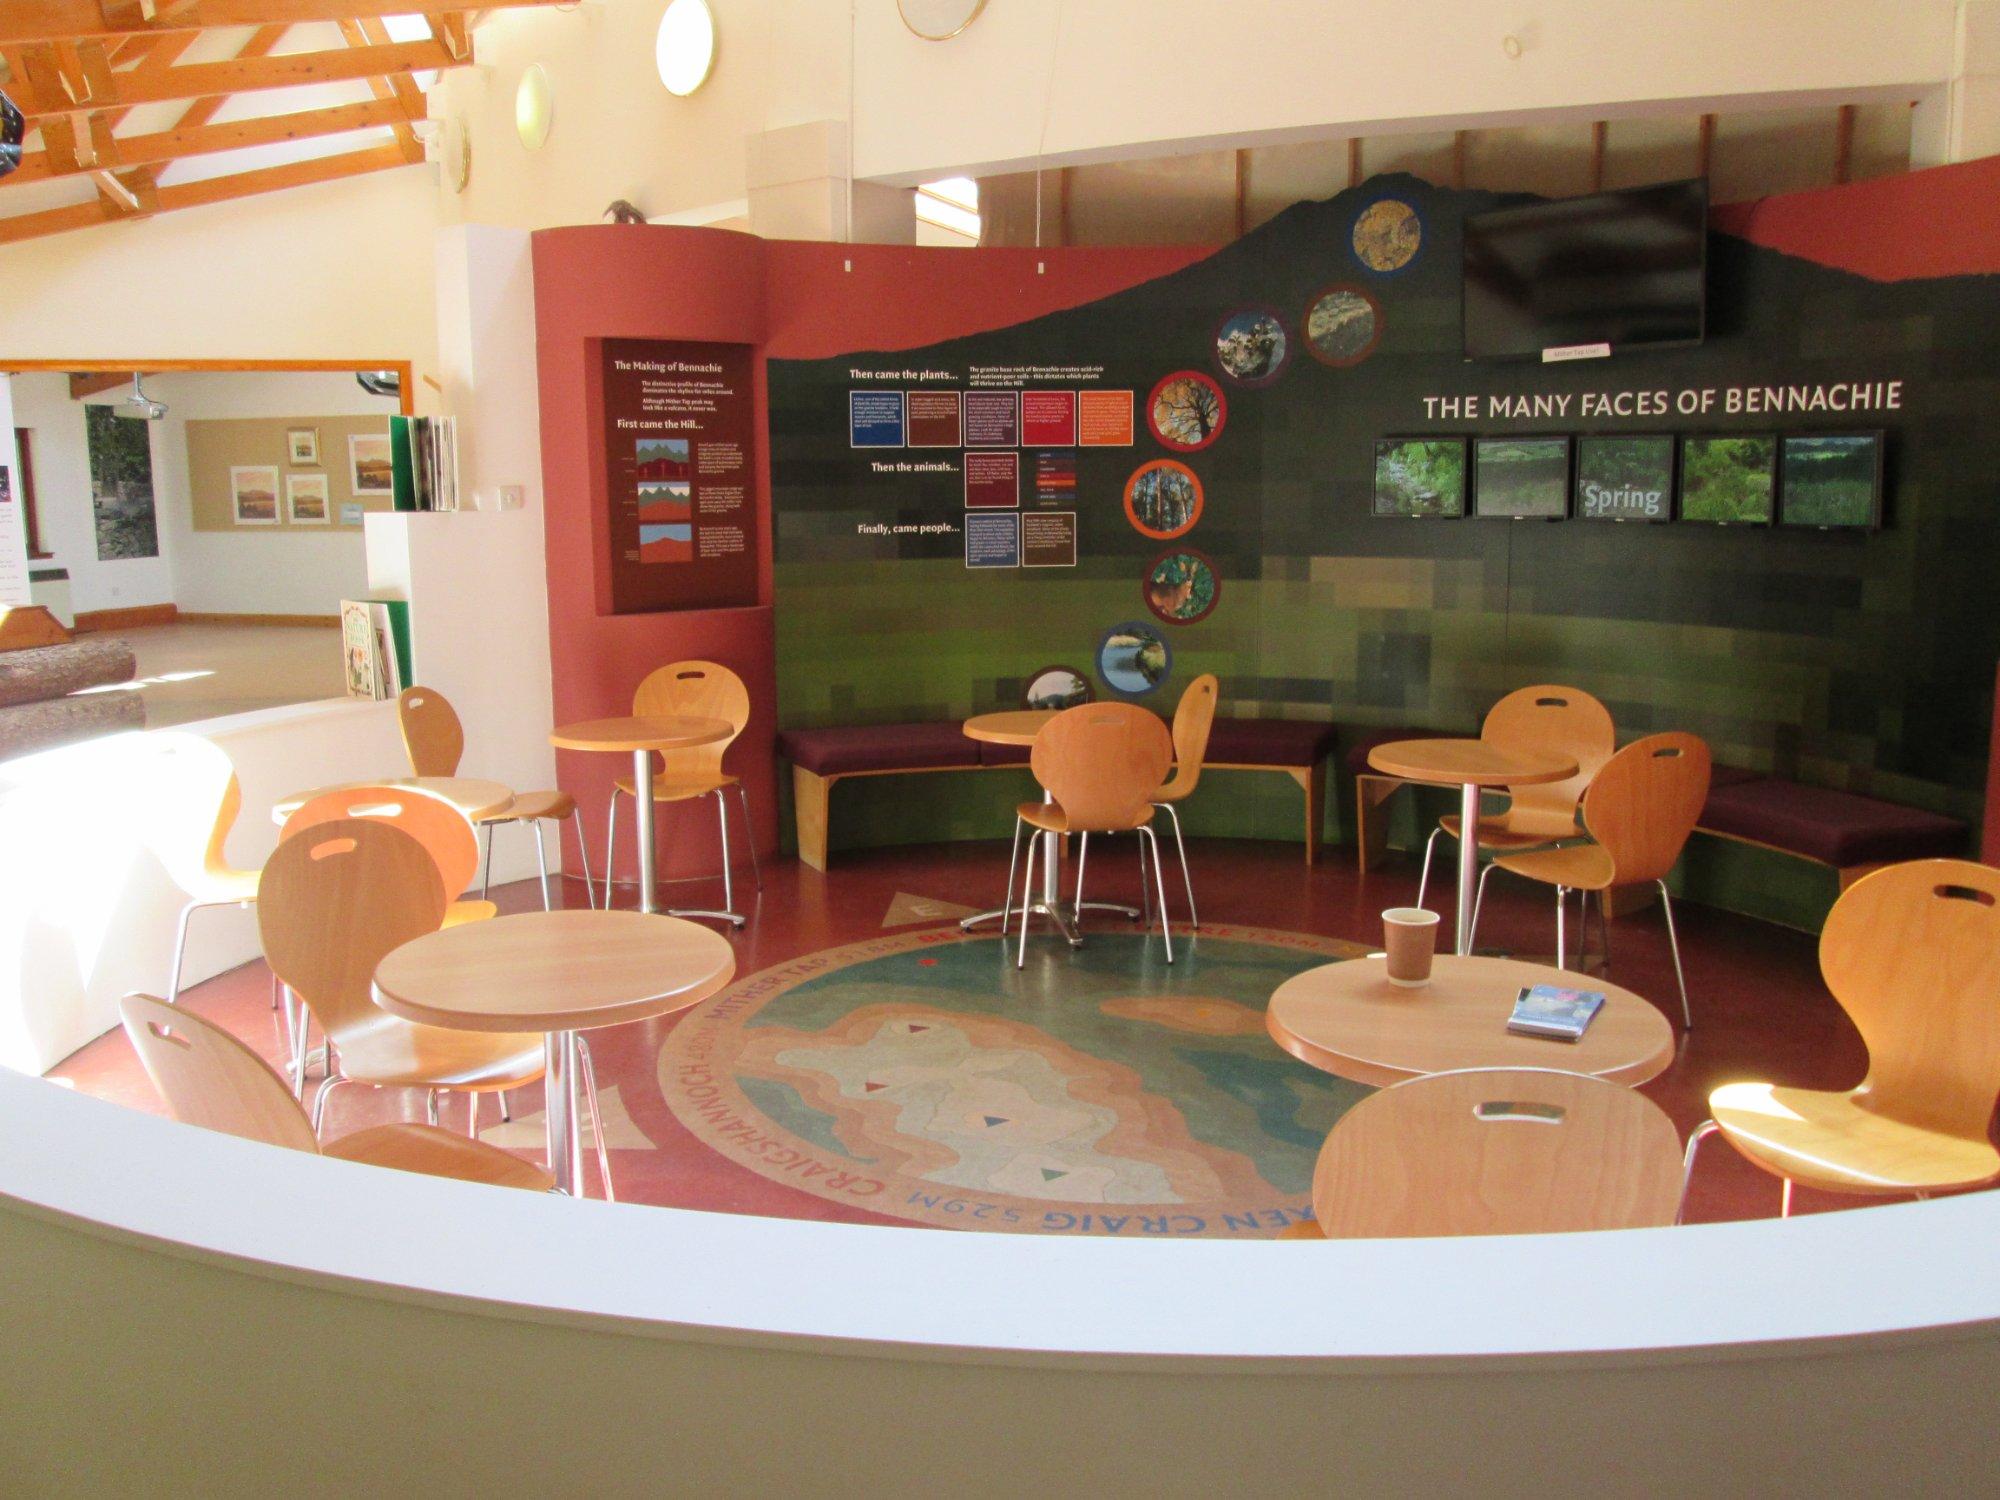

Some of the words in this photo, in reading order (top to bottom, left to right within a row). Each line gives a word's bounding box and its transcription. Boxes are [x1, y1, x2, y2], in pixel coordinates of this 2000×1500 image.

[614, 360, 631, 370] The
[633, 361, 666, 373] Making
[667, 361, 678, 371] of
[678, 362, 723, 373] Bennachie
[849, 368, 873, 379] Then
[875, 370, 900, 379] came
[902, 369, 918, 379] the
[920, 369, 959, 381] plants...
[1423, 396, 1479, 419] THE
[1489, 394, 1572, 419] MANY
[1581, 390, 1668, 417] FACES
[1676, 389, 1716, 414] OF
[1725, 381, 1902, 413] BENNACHIE
[617, 419, 638, 429] First
[639, 420, 664, 429] came
[664, 419, 679, 429] the
[680, 420, 704, 429] Hill...
[871, 462, 895, 472] Then
[896, 461, 912, 472] the
[914, 461, 960, 472] animals...
[1584, 483, 1662, 516] Spring
[858, 523, 891, 535] Finally,
[892, 524, 918, 533] came
[920, 522, 960, 535] people...
[704, 975, 786, 1021] MITHER
[784, 957, 829, 977] TAP
[679, 1063, 886, 1196] CRAIGSHANNOCH
[907, 1190, 1022, 1224] 529M
[1041, 1209, 1207, 1234] CRAIG
